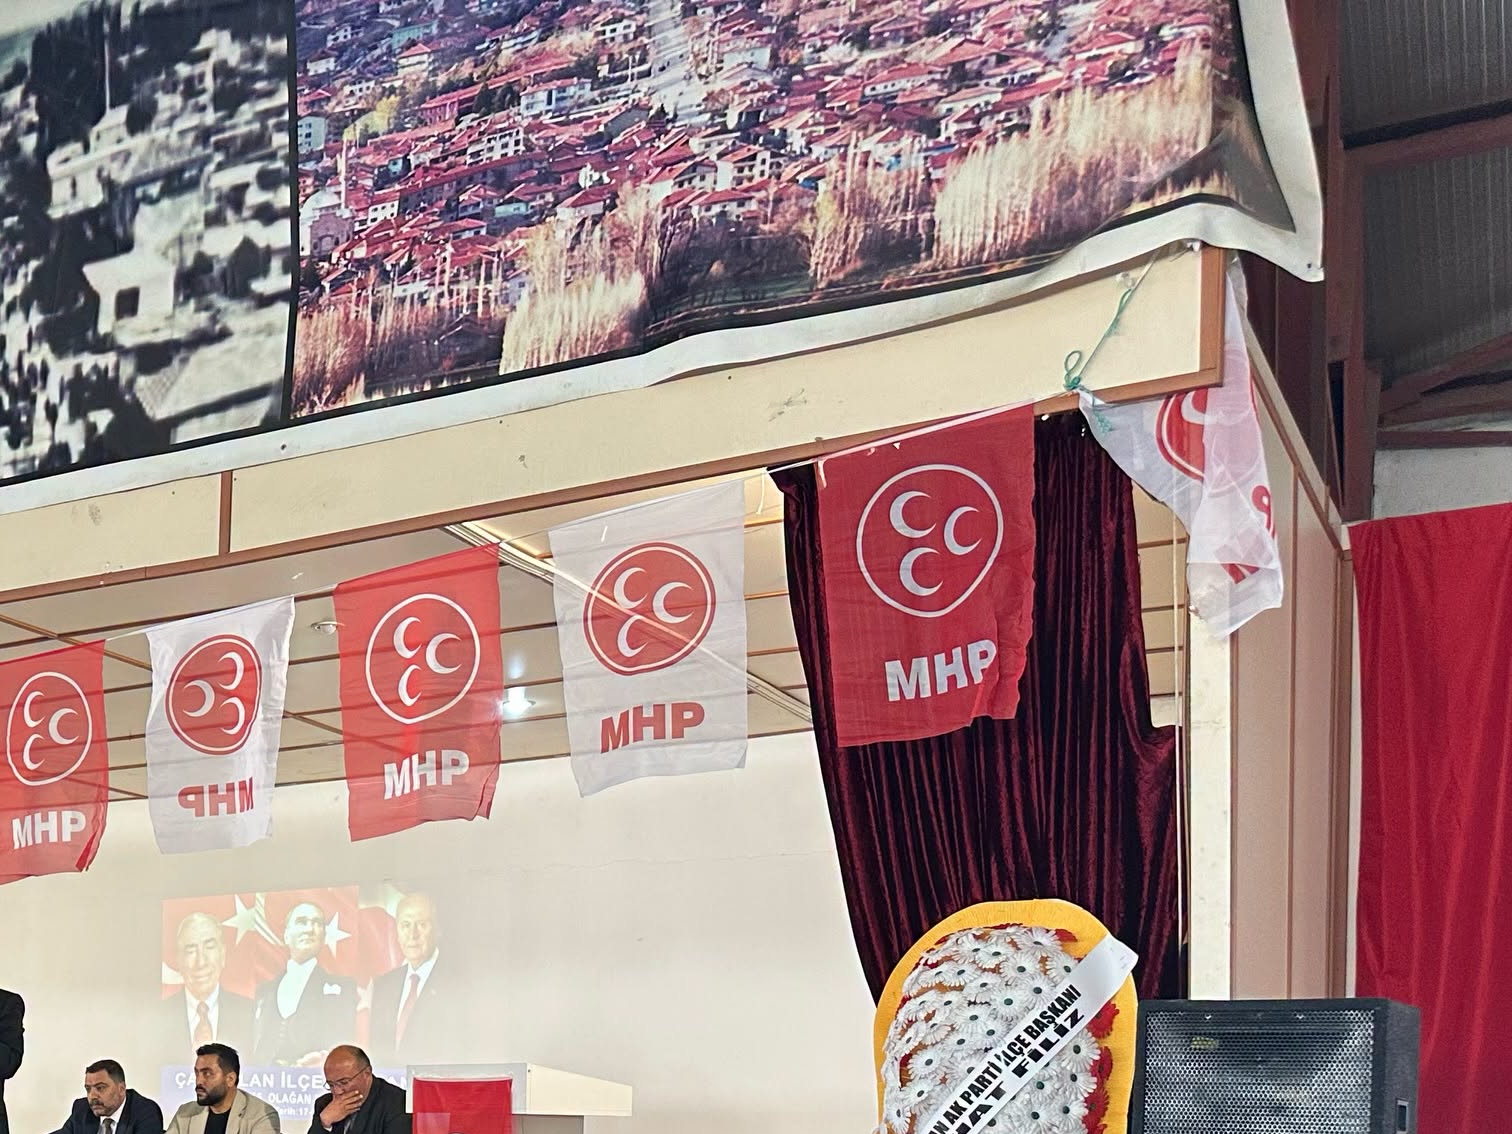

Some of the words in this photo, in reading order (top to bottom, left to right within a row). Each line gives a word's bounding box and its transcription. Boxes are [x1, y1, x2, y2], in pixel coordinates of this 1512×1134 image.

[884, 638, 999, 702] MHP
[601, 702, 705, 753] MHP
[383, 750, 471, 799] MHP
[12, 810, 86, 849] MHP
[943, 1101, 967, 1125] AK
[961, 1061, 1003, 1108] PARTİ
[994, 1034, 1031, 1067] İLÇE
[1023, 984, 1082, 1040] BAŞKANI
